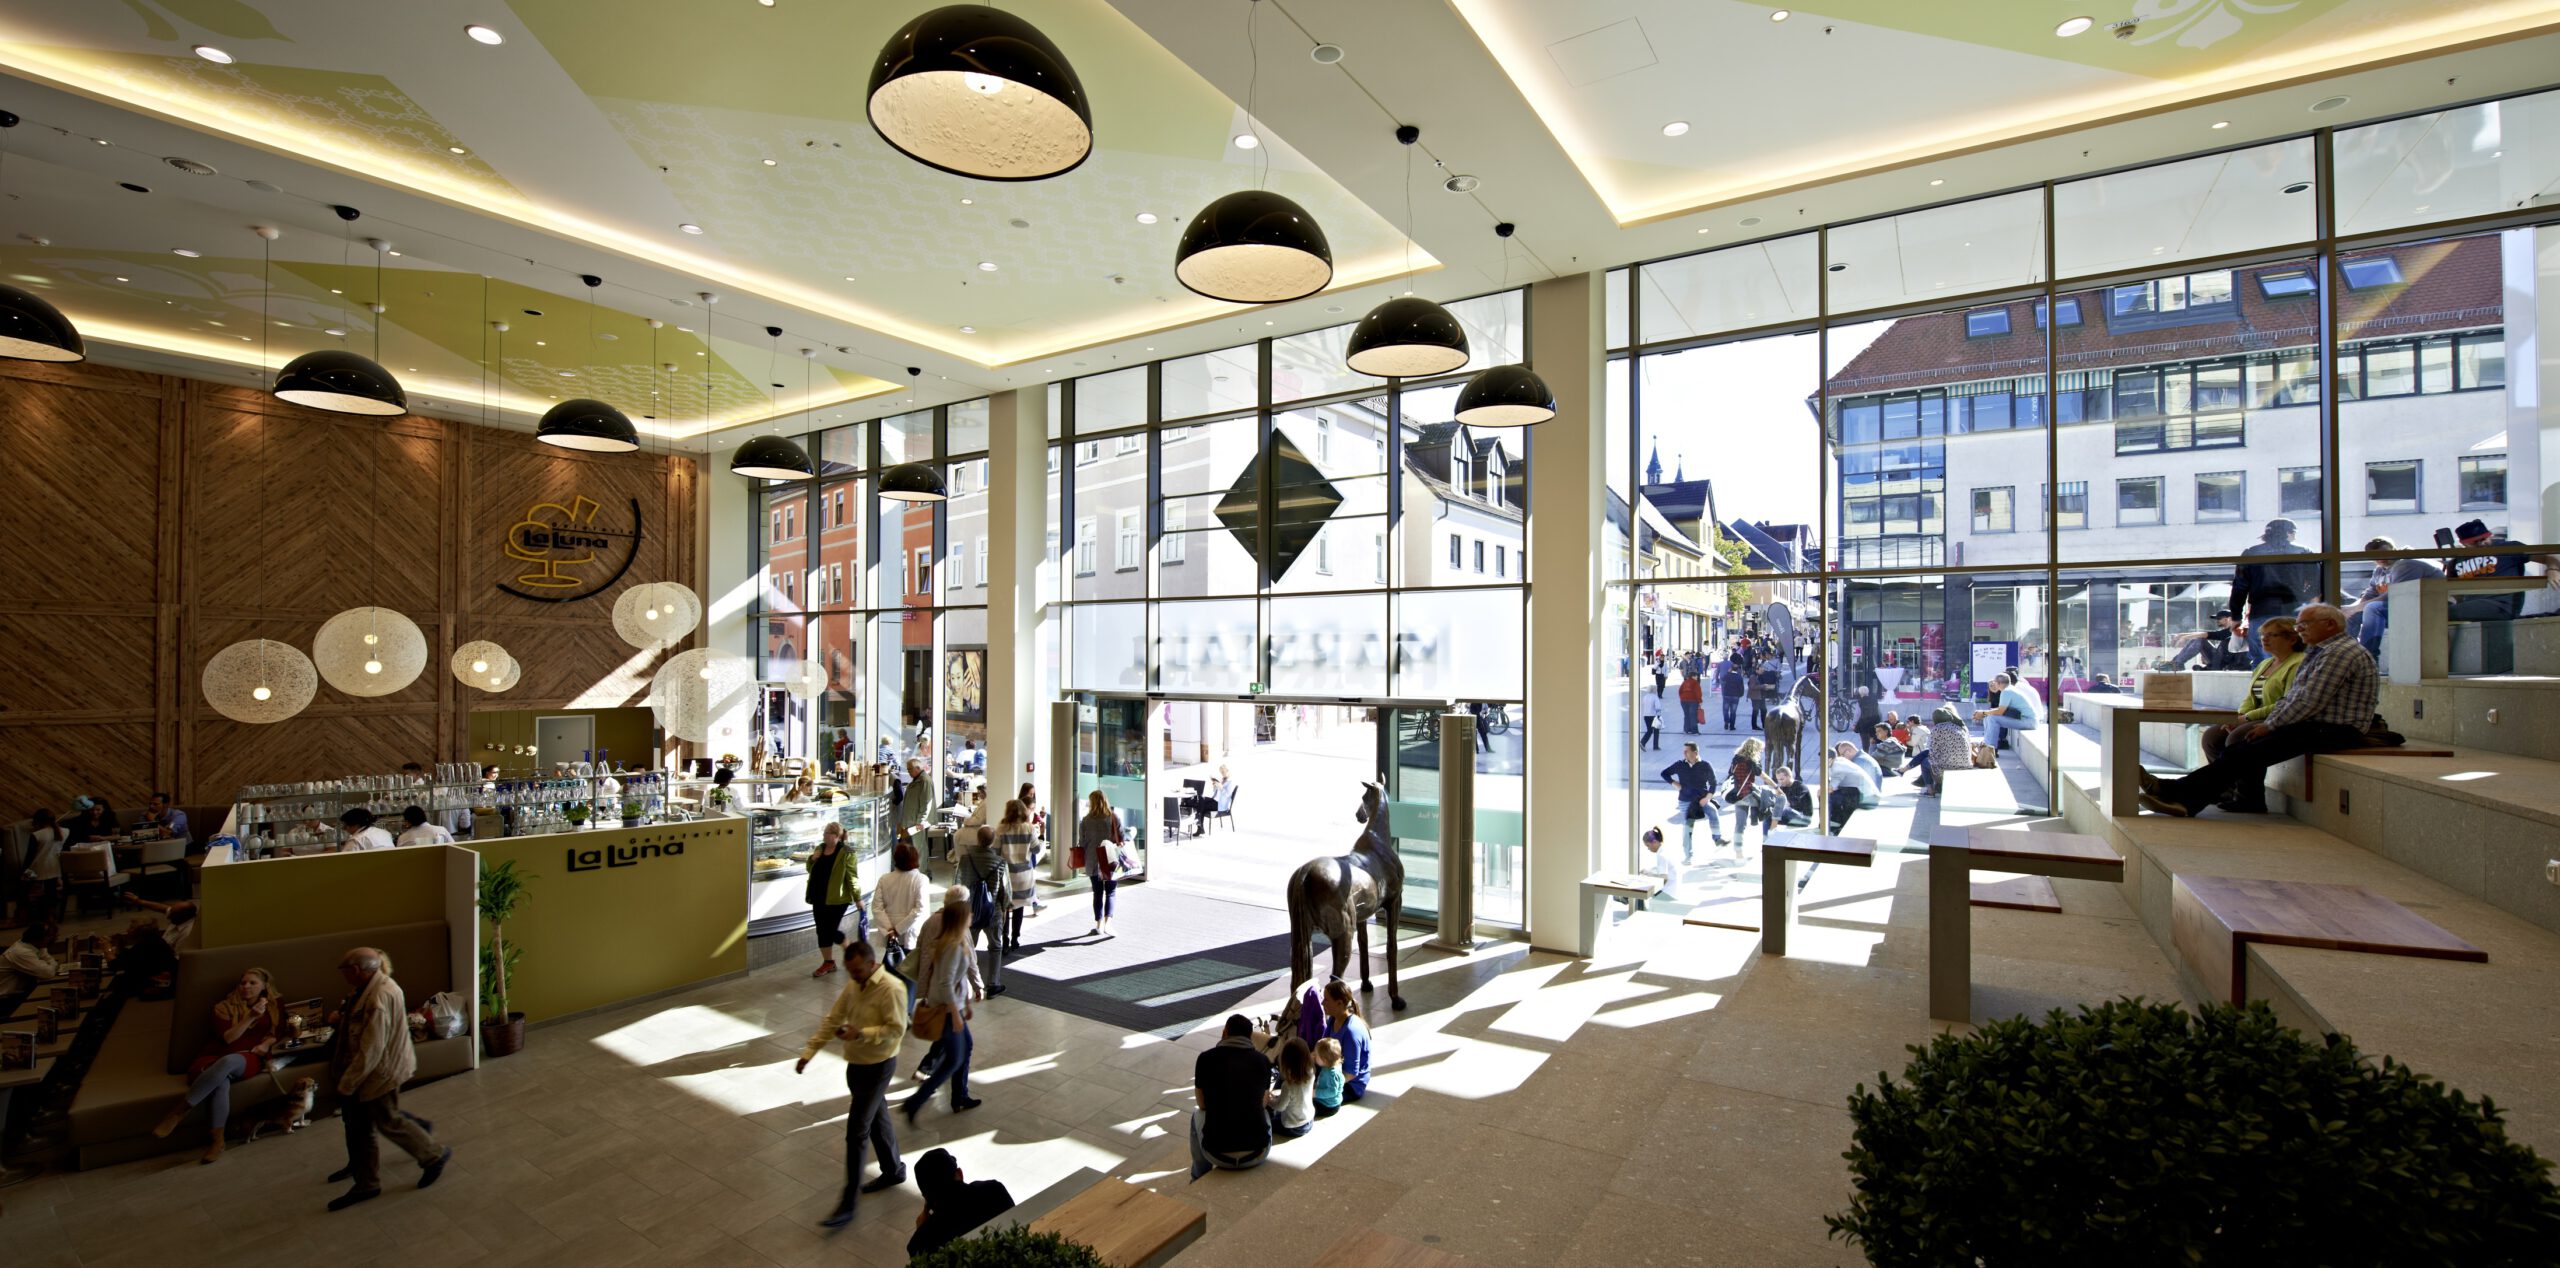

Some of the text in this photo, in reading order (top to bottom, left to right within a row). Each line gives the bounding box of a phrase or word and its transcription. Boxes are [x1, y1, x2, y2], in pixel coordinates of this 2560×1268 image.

[523, 529, 608, 550] La Luna
[630, 829, 733, 845] Gelateria
[567, 842, 684, 872] La Luna
